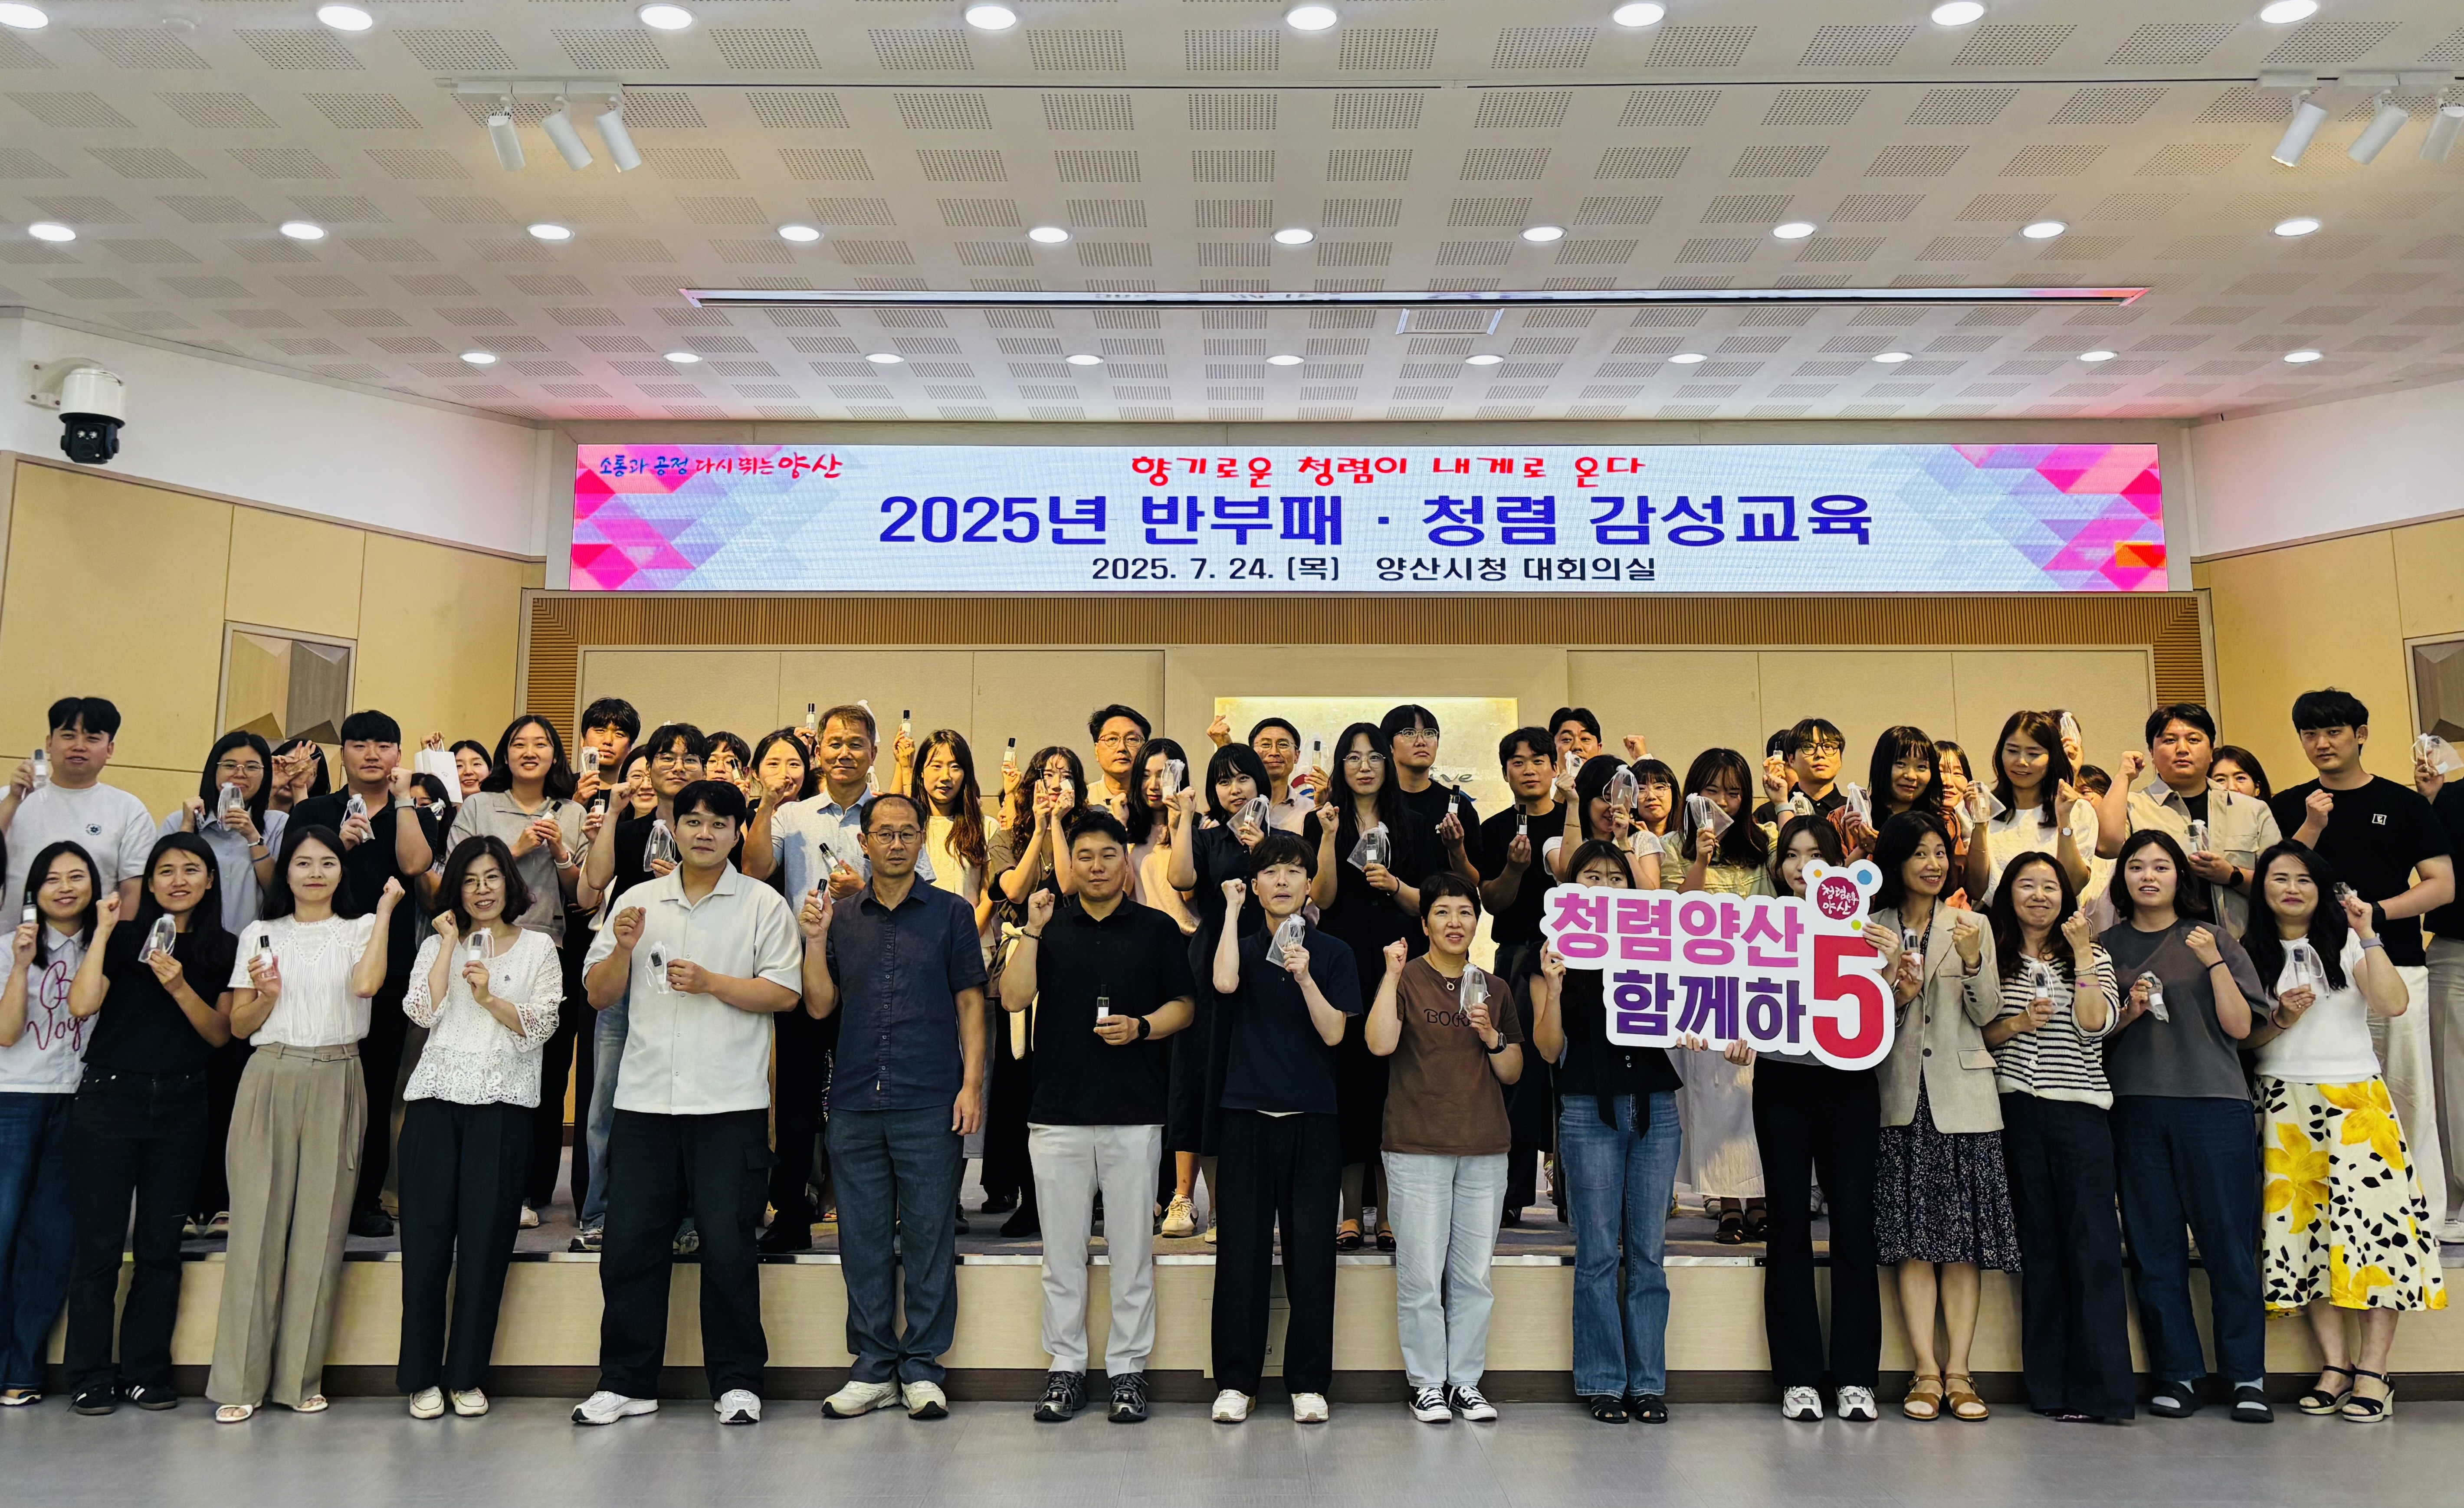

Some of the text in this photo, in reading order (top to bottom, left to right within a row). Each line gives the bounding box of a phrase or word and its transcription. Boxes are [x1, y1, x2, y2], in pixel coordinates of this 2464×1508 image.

[600, 452, 843, 479] 소통과 공정 다시 뛰는 양산
[1131, 456, 1646, 488] 향기로운 청렴이 내게로 온다
[879, 495, 1106, 545] 2025년
[1142, 495, 1342, 546] 반부패
[1422, 495, 1556, 547] 청렴
[1590, 495, 1872, 547] 감성교육
[1092, 557, 1176, 580] 2025.
[1190, 557, 1215, 580] 7.
[1229, 557, 1273, 580] 24.
[1376, 557, 1506, 581] 양산시청
[1523, 557, 1655, 581] 대회의실
[1822, 900, 1852, 915] 양산
[1551, 892, 1805, 968] 청렴양산
